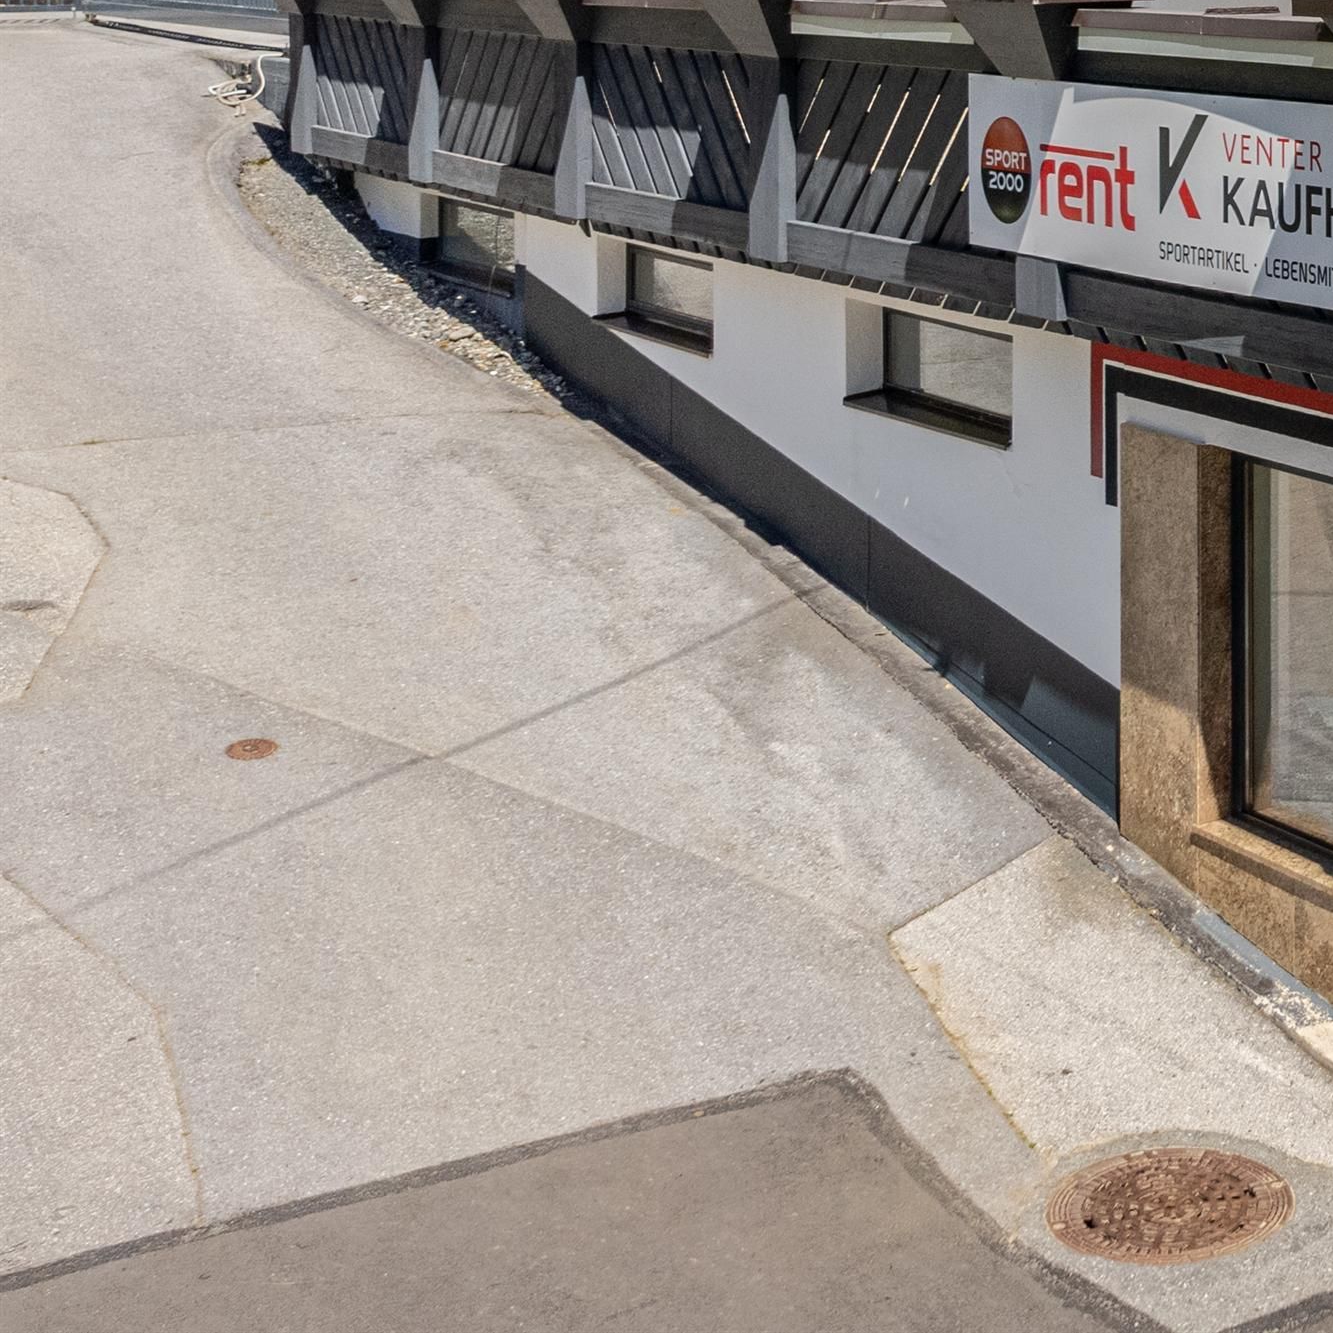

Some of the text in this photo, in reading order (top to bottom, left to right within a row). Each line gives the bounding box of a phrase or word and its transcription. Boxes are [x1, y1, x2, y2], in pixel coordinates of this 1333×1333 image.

[985, 148, 1028, 171] SPORT
[1222, 132, 1323, 173] VENTER
[988, 171, 1024, 193] 2000
[1039, 144, 1136, 232] rent
[1158, 240, 1249, 274] SPORTARTIKEL
